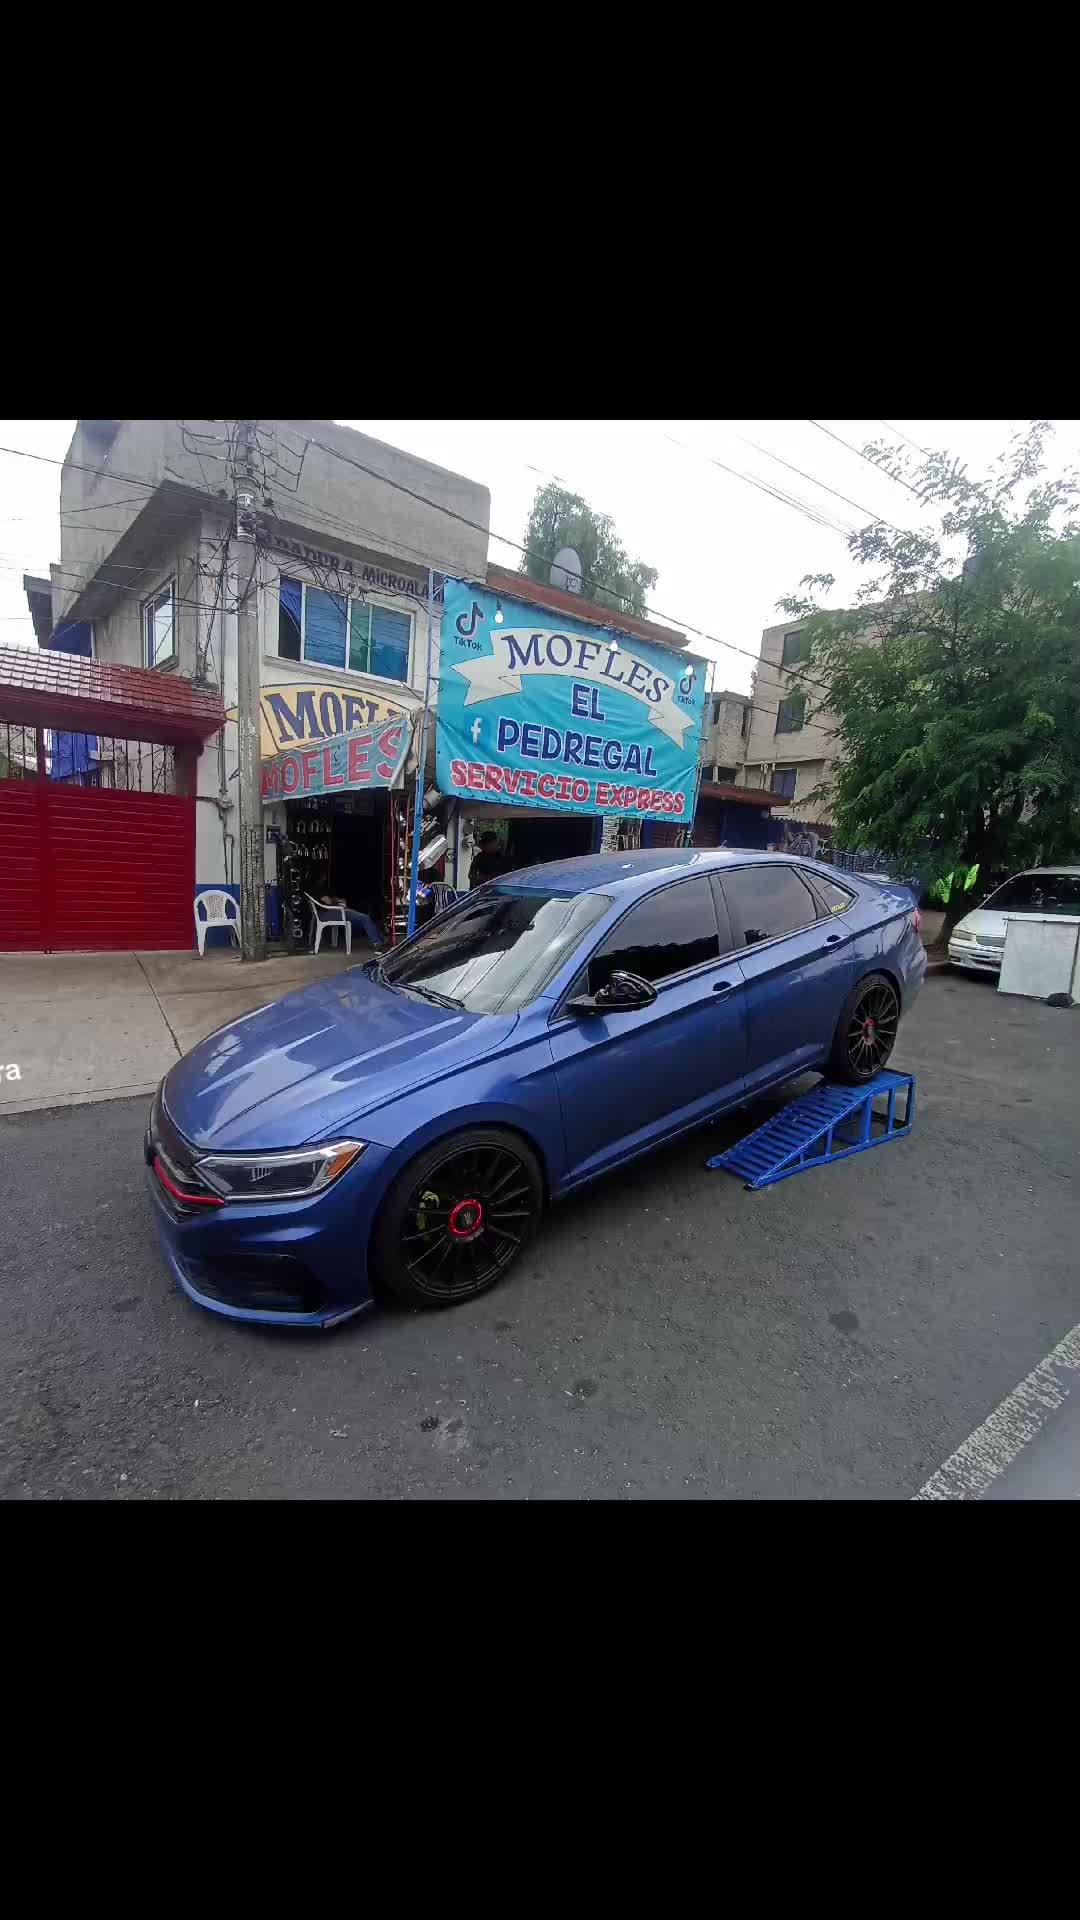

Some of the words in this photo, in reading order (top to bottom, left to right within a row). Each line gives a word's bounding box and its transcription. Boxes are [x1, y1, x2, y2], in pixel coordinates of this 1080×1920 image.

[453, 635, 483, 652] TikTok
[501, 633, 669, 703] MOFLES
[571, 683, 606, 721] EL
[261, 726, 404, 799] MOFLES
[497, 717, 657, 777] PEDREGAL
[450, 759, 589, 803] SERVICIO
[595, 780, 685, 814] EXPRESS
